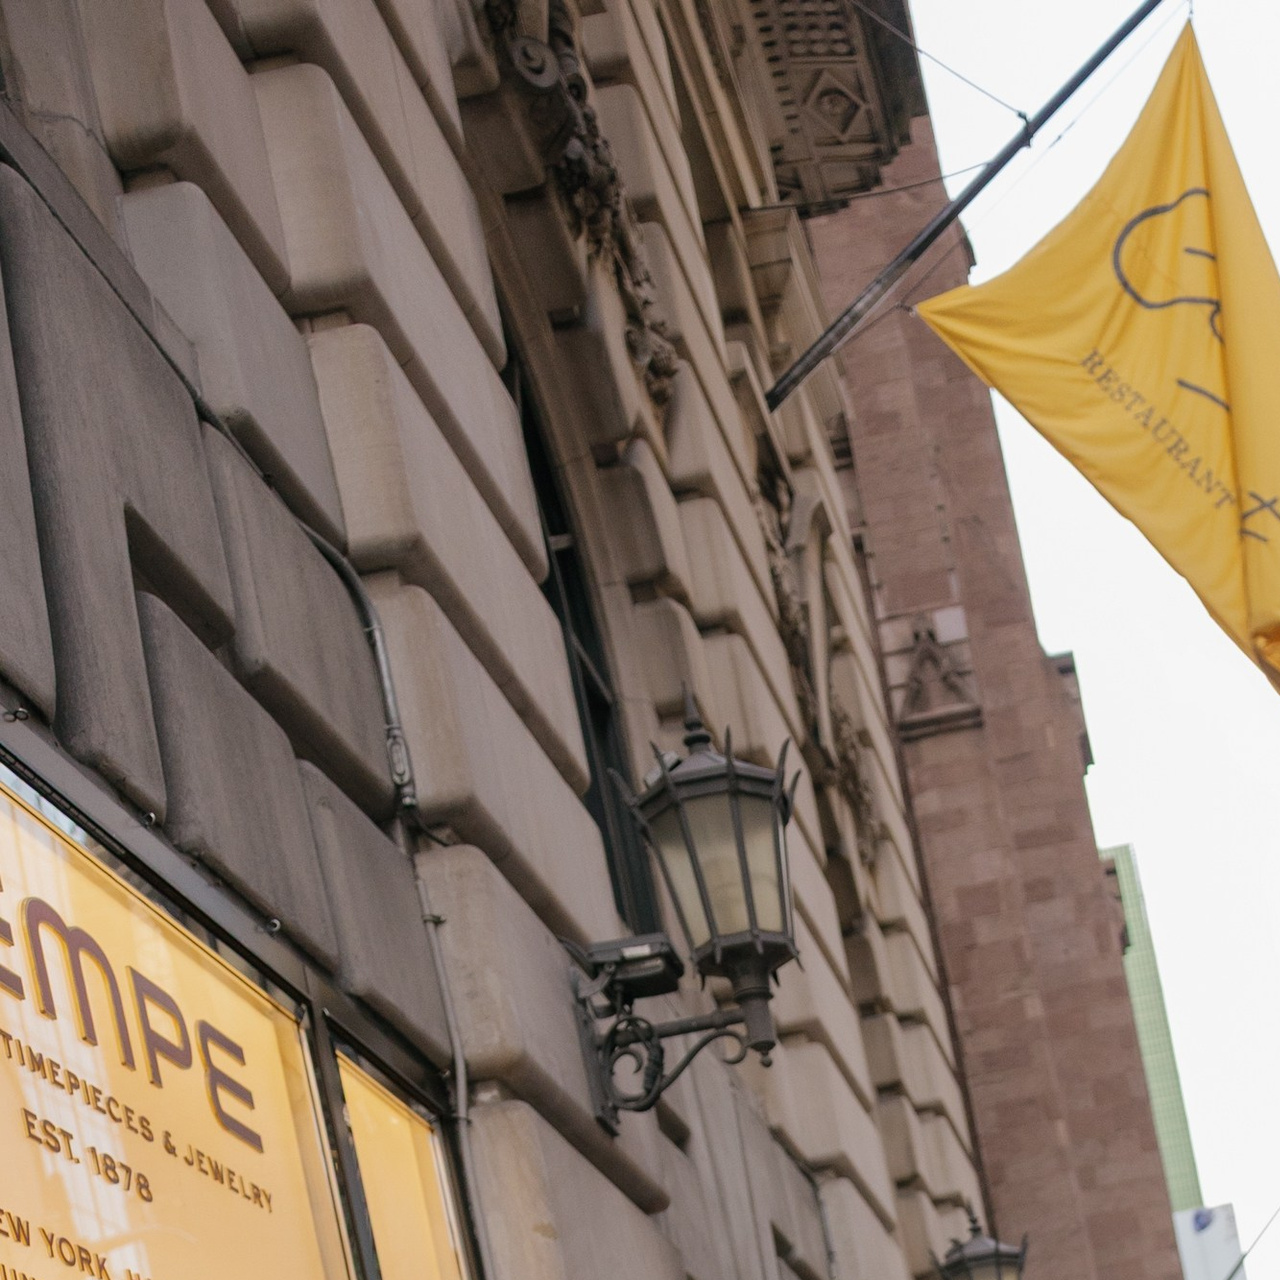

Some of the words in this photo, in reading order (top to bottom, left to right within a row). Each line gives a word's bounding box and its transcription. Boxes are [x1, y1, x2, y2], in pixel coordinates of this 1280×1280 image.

[1080, 348, 1236, 509] RESTAURANT
[0, 1028, 155, 1143] TIMEPIECES
[163, 1130, 178, 1158] &
[184, 1144, 273, 1214] JEWELRY
[21, 1108, 80, 1164] EST.
[87, 1146, 153, 1203] 1878
